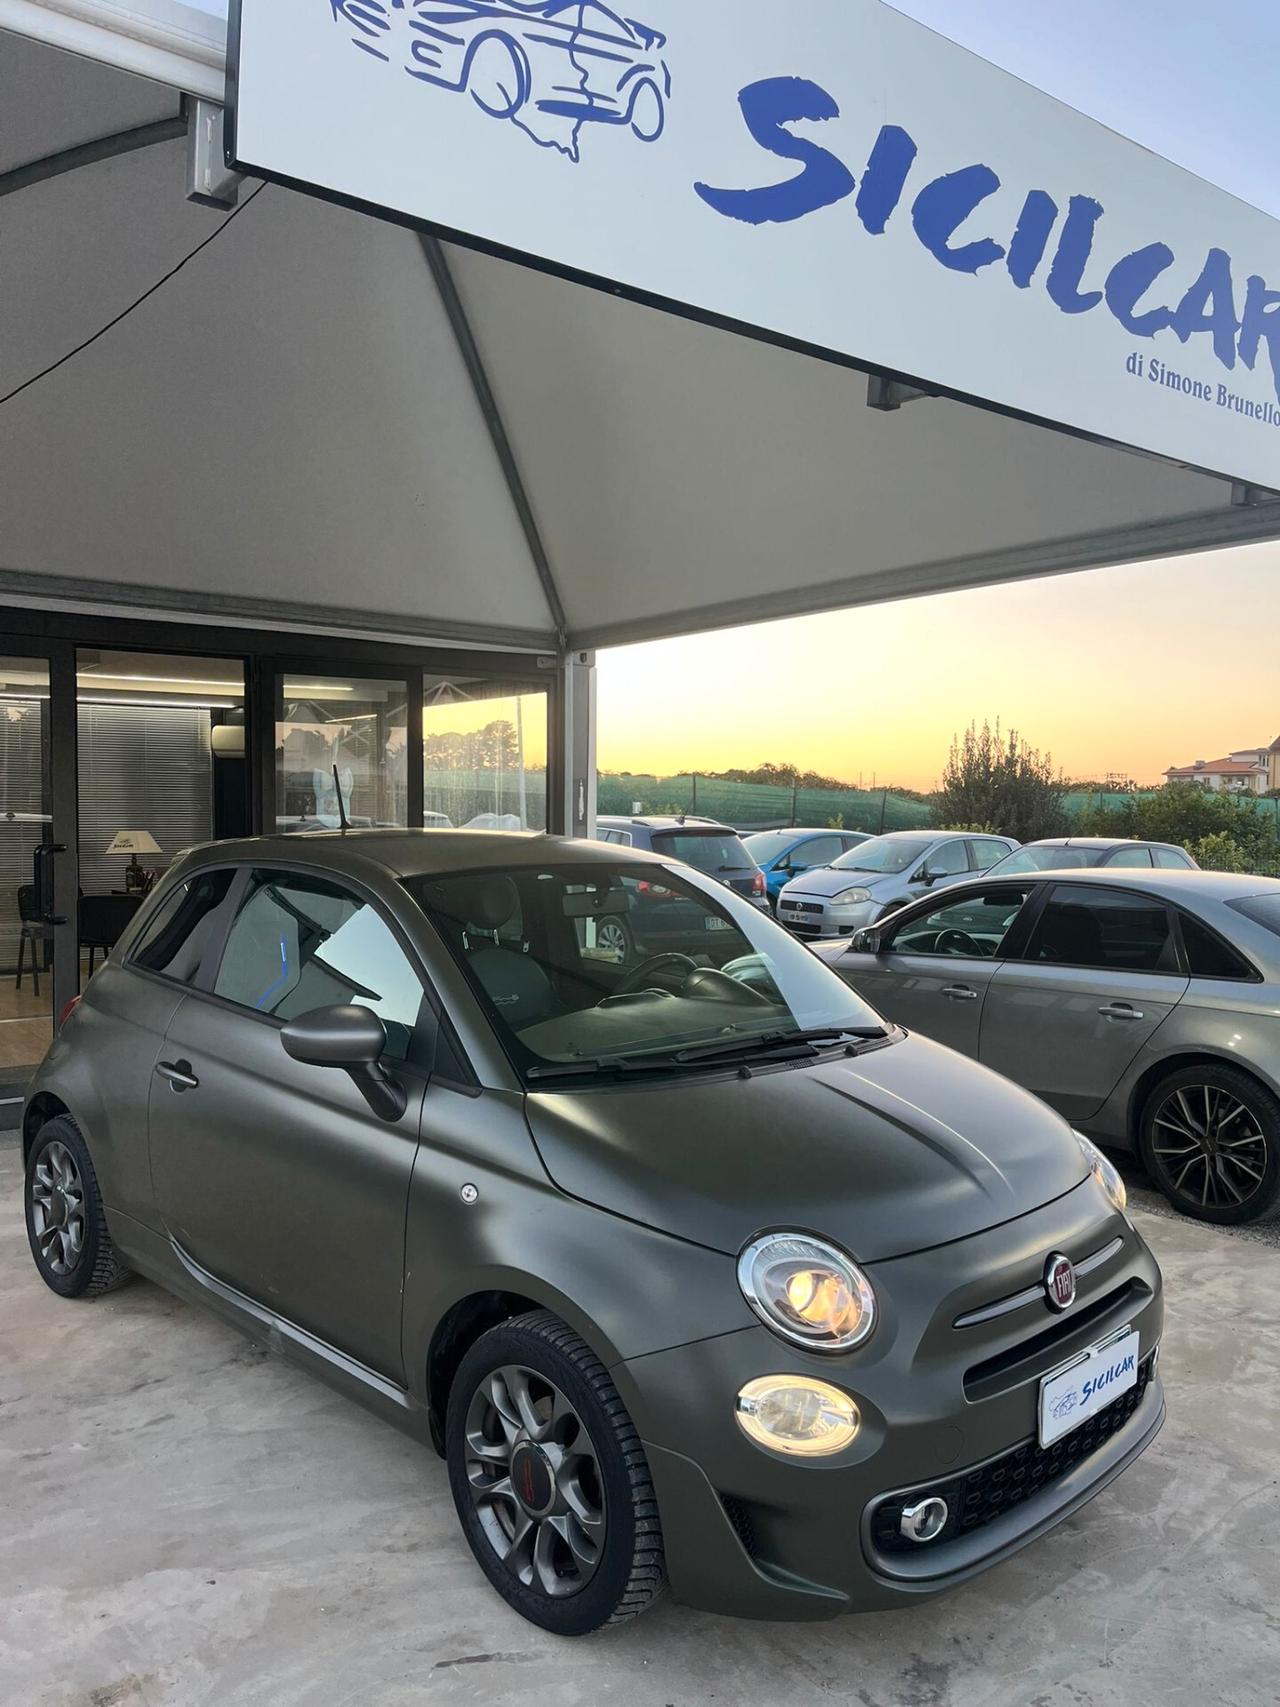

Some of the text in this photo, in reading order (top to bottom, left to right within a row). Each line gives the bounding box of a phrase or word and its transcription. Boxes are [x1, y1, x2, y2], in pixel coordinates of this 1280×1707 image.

[1126, 352, 1280, 427] di Simone Brunello
[1056, 1269, 1071, 1298] FIAT
[1080, 1354, 1134, 1406] SICILCAR
